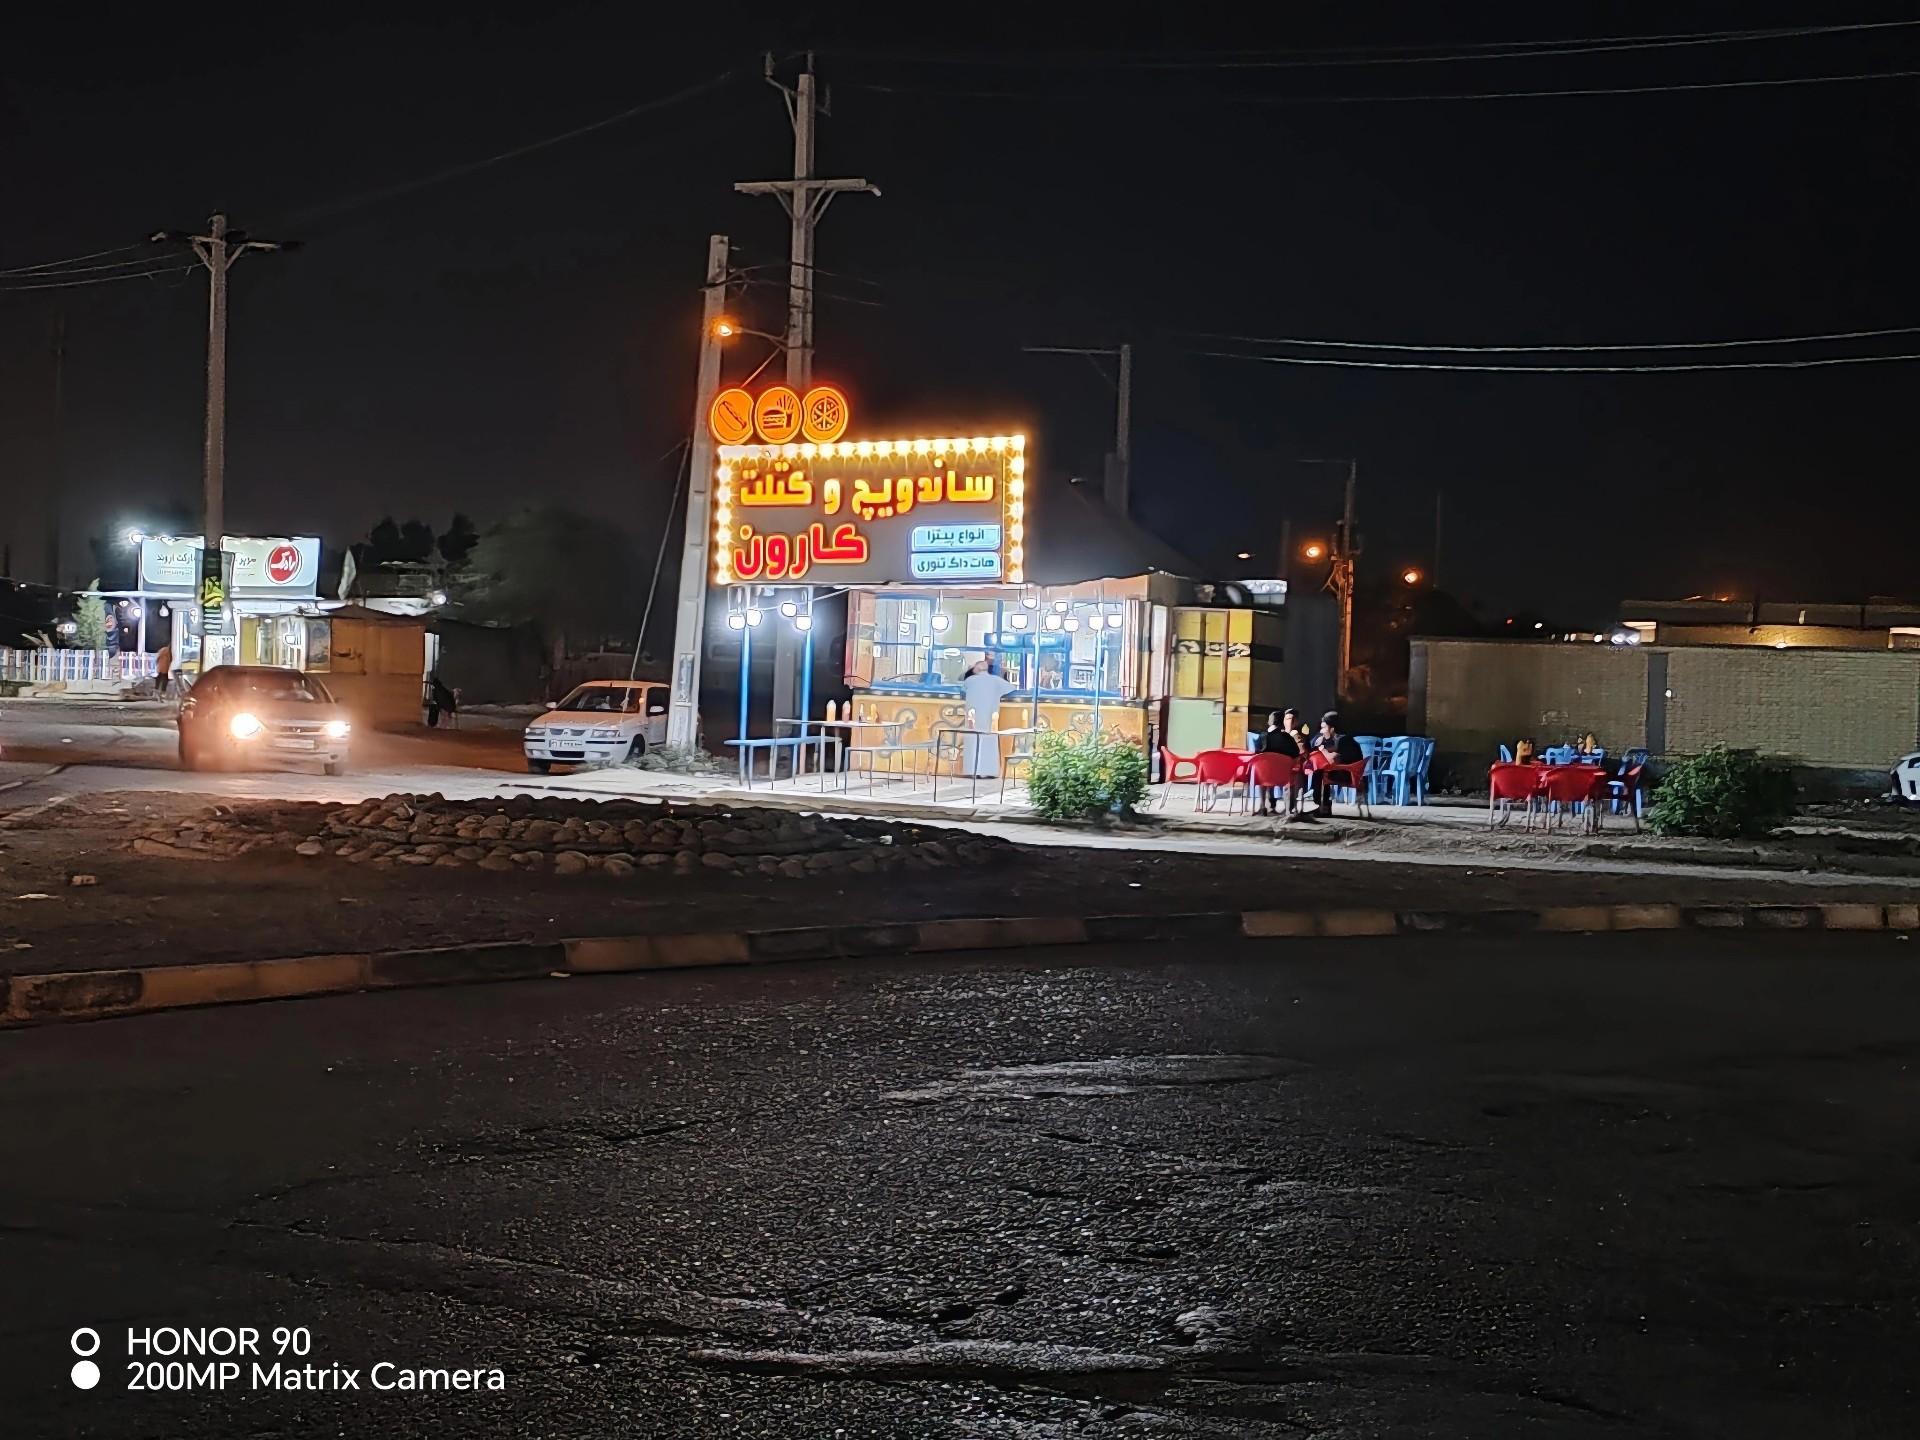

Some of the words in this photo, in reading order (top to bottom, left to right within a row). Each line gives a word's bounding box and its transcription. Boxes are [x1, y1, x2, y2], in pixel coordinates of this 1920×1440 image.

[740, 460, 813, 506] کتلت
[823, 477, 841, 515] و
[851, 458, 995, 521] ساندویچ
[927, 528, 954, 546] پیتزا
[958, 528, 985, 544] انواع
[733, 522, 869, 580] کارون
[917, 557, 946, 572] تنوری
[970, 557, 995, 568] هات
